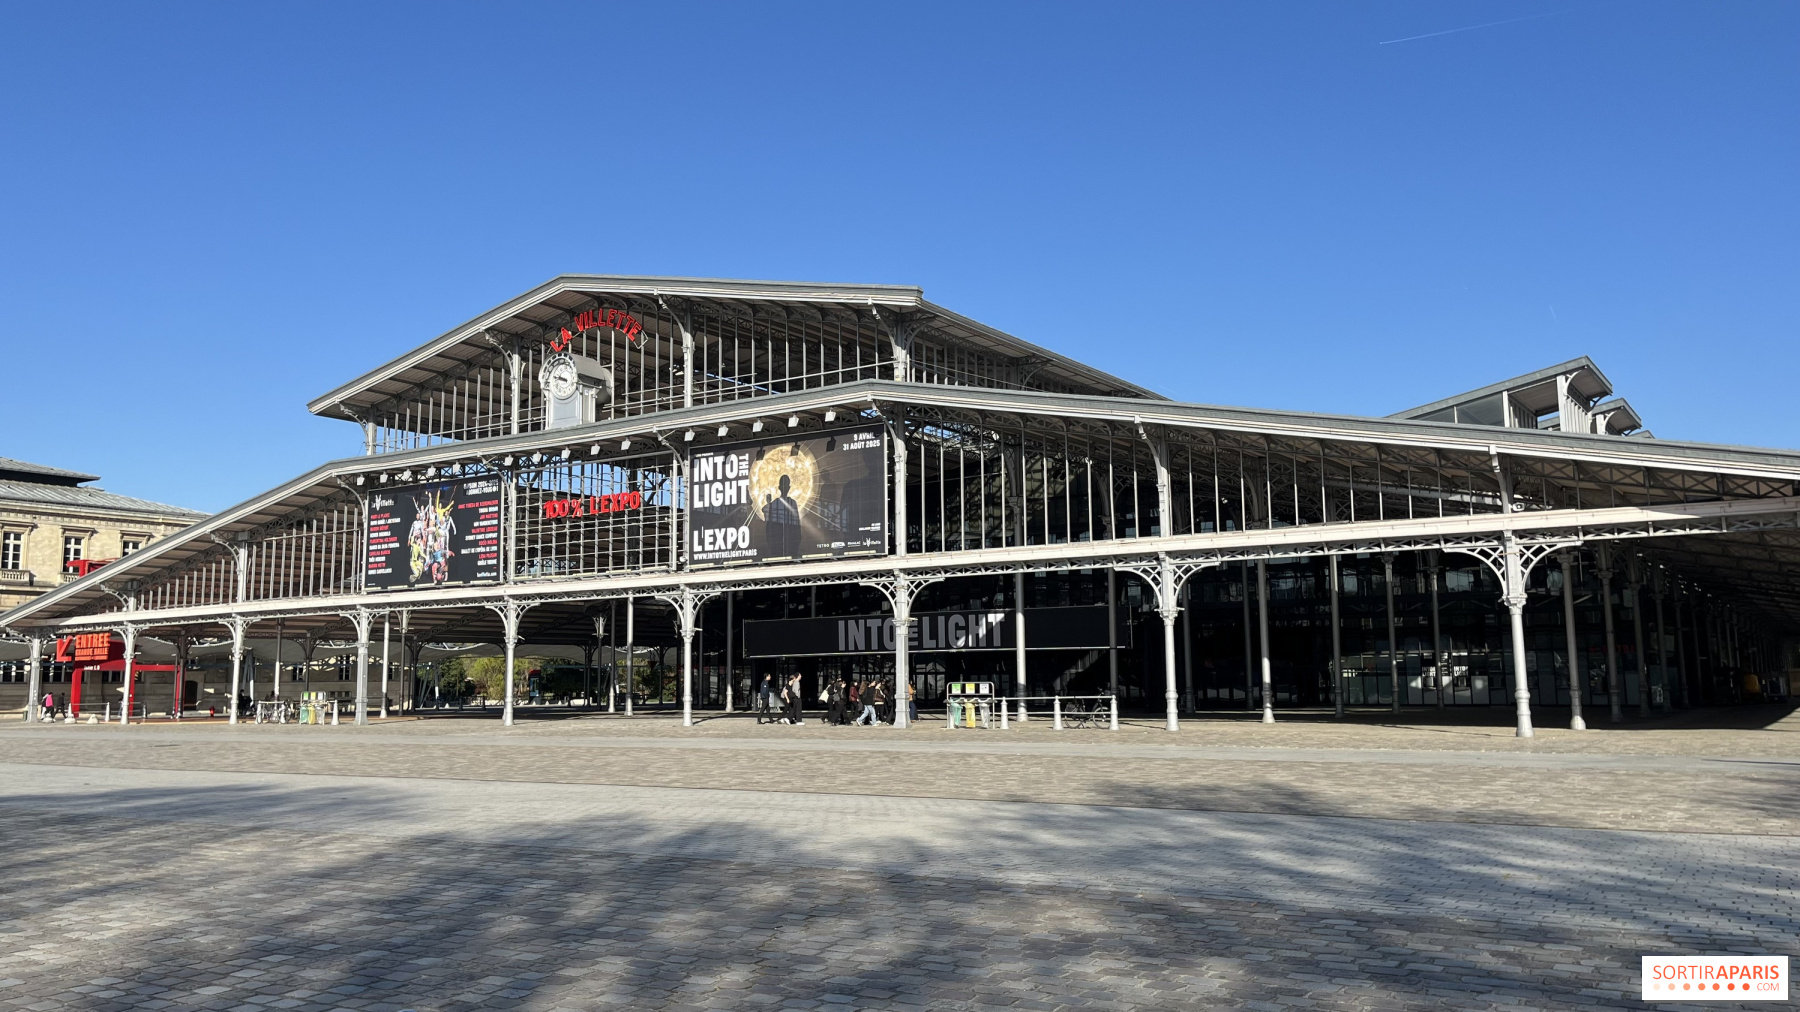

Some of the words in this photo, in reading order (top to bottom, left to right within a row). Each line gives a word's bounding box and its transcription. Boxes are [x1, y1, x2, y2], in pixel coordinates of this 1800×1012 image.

[550, 327, 573, 352] LA
[574, 308, 642, 342] VILLETTE
[694, 454, 739, 482] INTO
[739, 453, 750, 477] THE
[543, 498, 583, 519] 100%
[589, 490, 640, 514] L'EXPO
[694, 479, 750, 508] LIGHT
[694, 526, 750, 552] L'EXPO
[838, 617, 896, 651] INTO
[922, 613, 1005, 649] LIGHT
